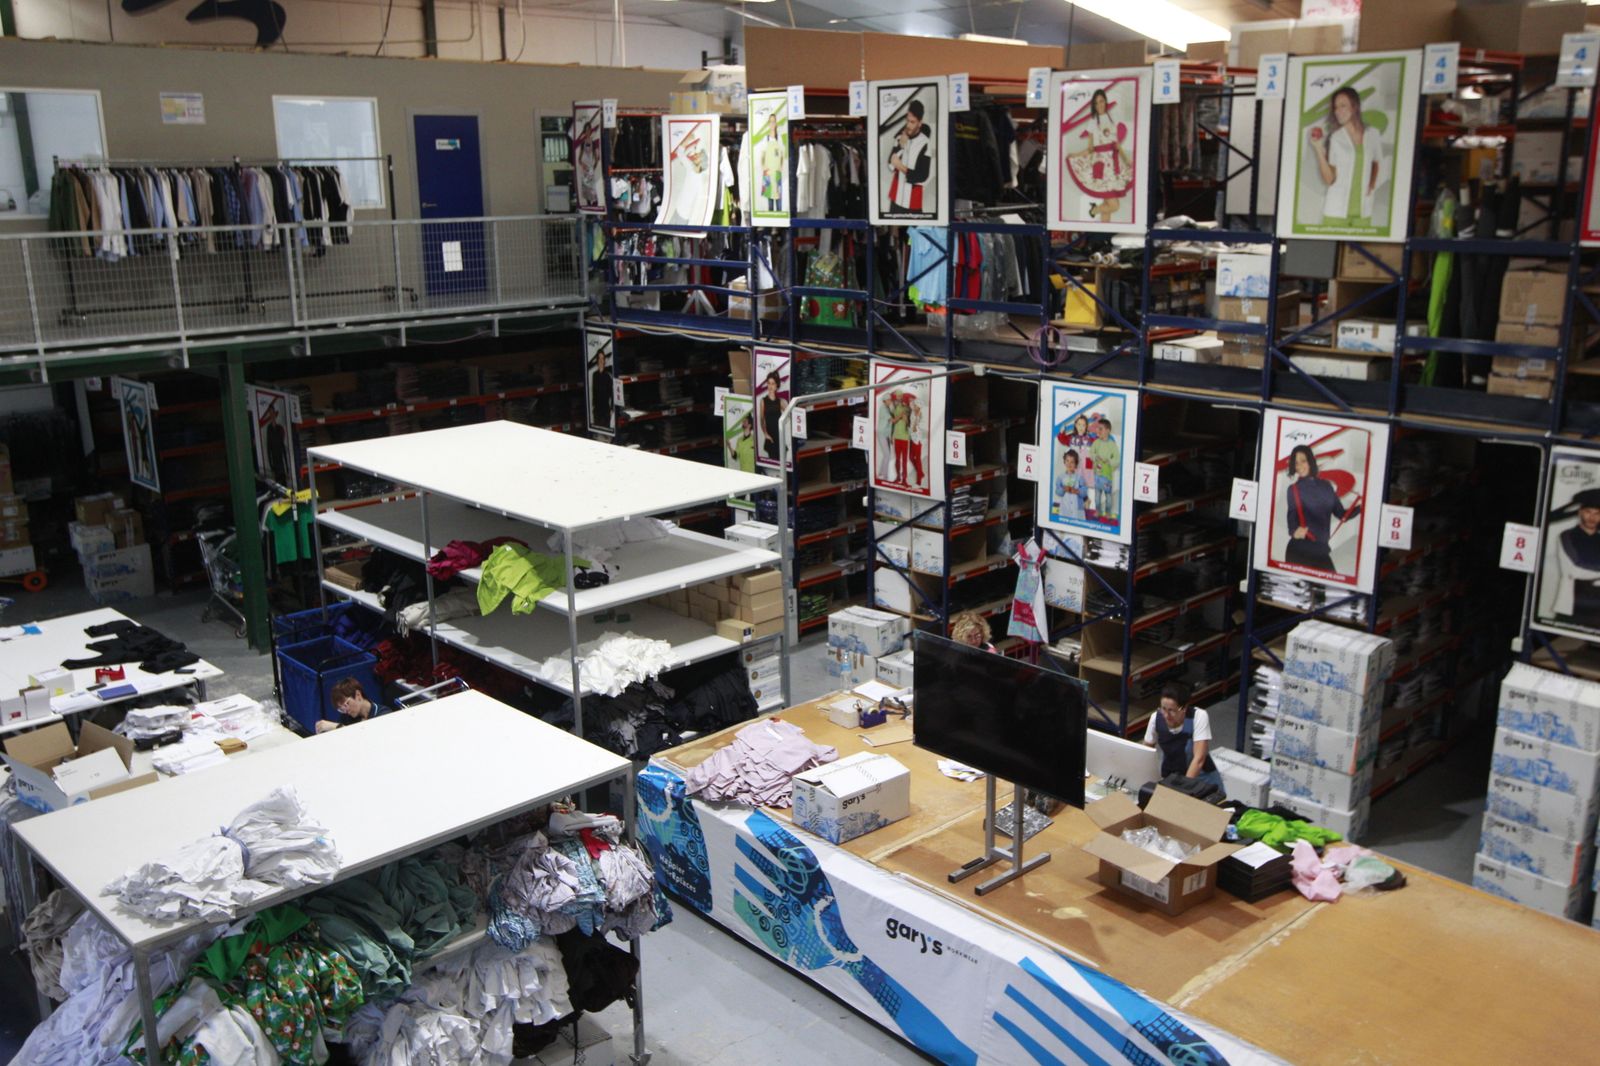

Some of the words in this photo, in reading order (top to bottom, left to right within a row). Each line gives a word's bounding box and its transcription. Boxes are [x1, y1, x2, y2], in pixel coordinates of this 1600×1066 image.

[1574, 47, 1587, 61] 4
[1435, 56, 1447, 68] 4
[1268, 65, 1277, 78] 3
[1163, 71, 1171, 84] 3
[1434, 72, 1445, 84] B
[955, 83, 962, 94] 2
[1036, 78, 1043, 89] 2
[1266, 80, 1276, 90] A
[953, 440, 959, 449] 6
[1026, 454, 1033, 463] 6
[1143, 474, 1150, 483] 7
[1142, 486, 1149, 494] B
[1241, 490, 1249, 500] 7
[1240, 504, 1247, 512] A
[1392, 517, 1401, 529] 8
[1391, 531, 1399, 540] B
[1516, 537, 1526, 549] 8
[1514, 552, 1524, 561] A
